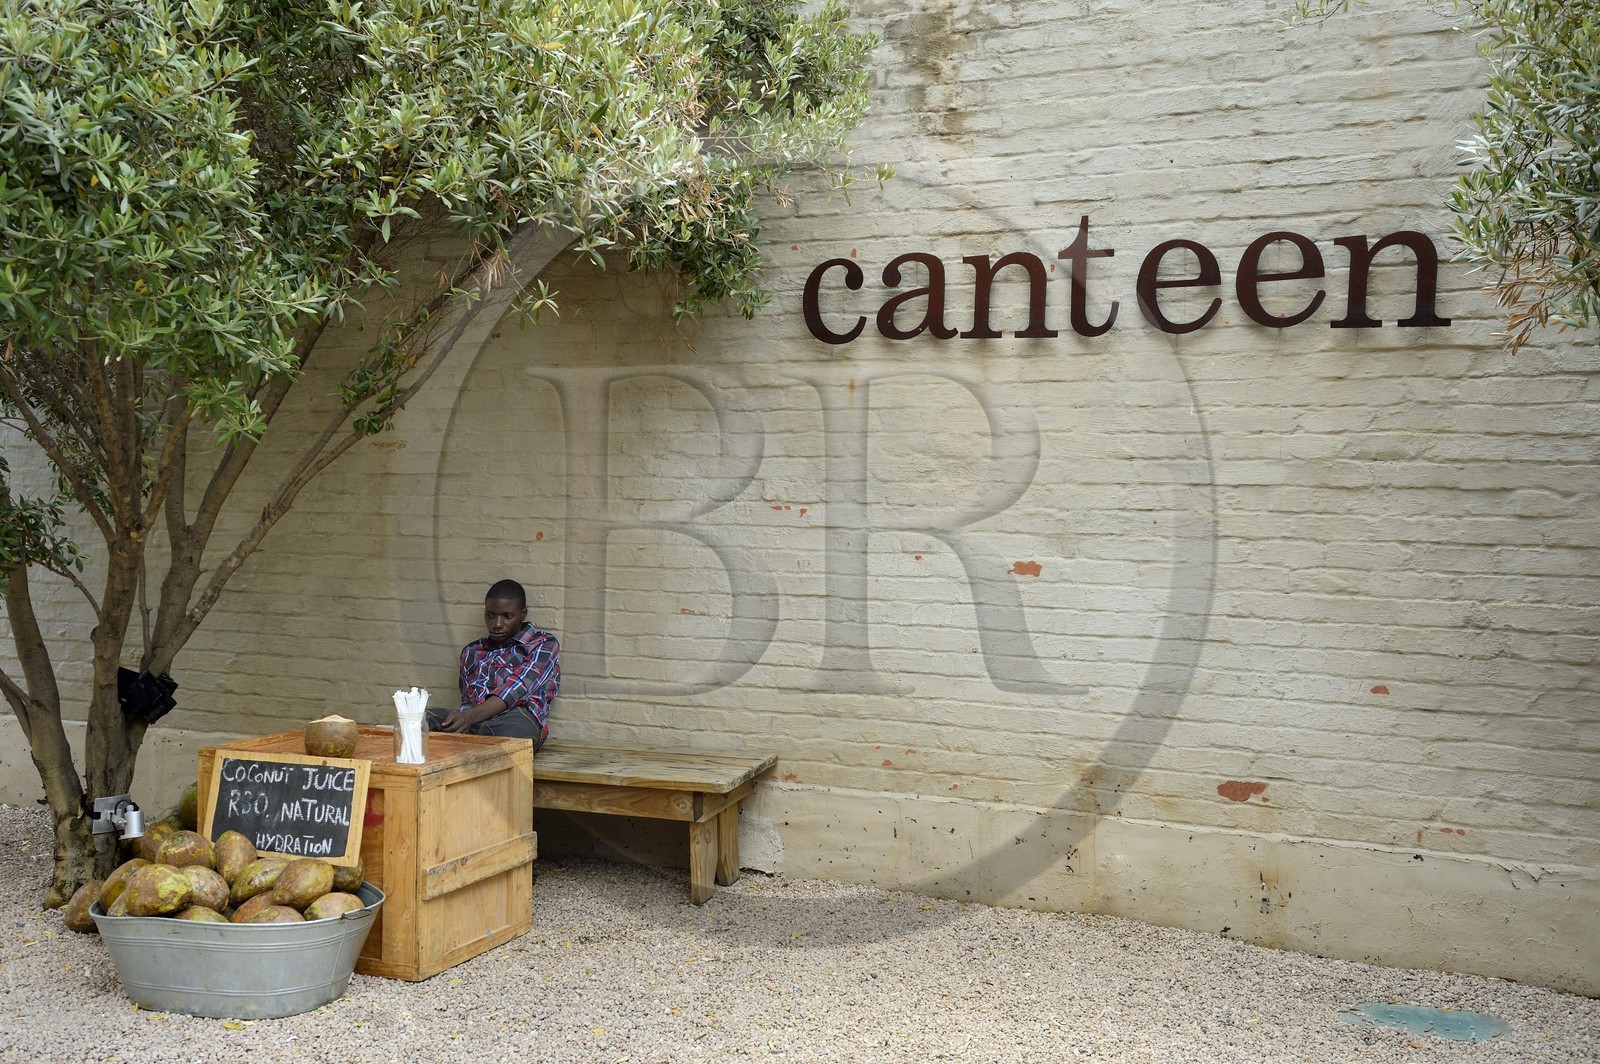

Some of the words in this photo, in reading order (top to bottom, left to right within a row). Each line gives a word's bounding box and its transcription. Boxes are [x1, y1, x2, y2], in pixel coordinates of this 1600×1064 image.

[802, 215, 1452, 345] canteen
[222, 758, 294, 784] COCONUT
[302, 766, 355, 791] JUICE
[280, 798, 350, 826] NATURAL
[255, 832, 332, 854] HYDRATION
